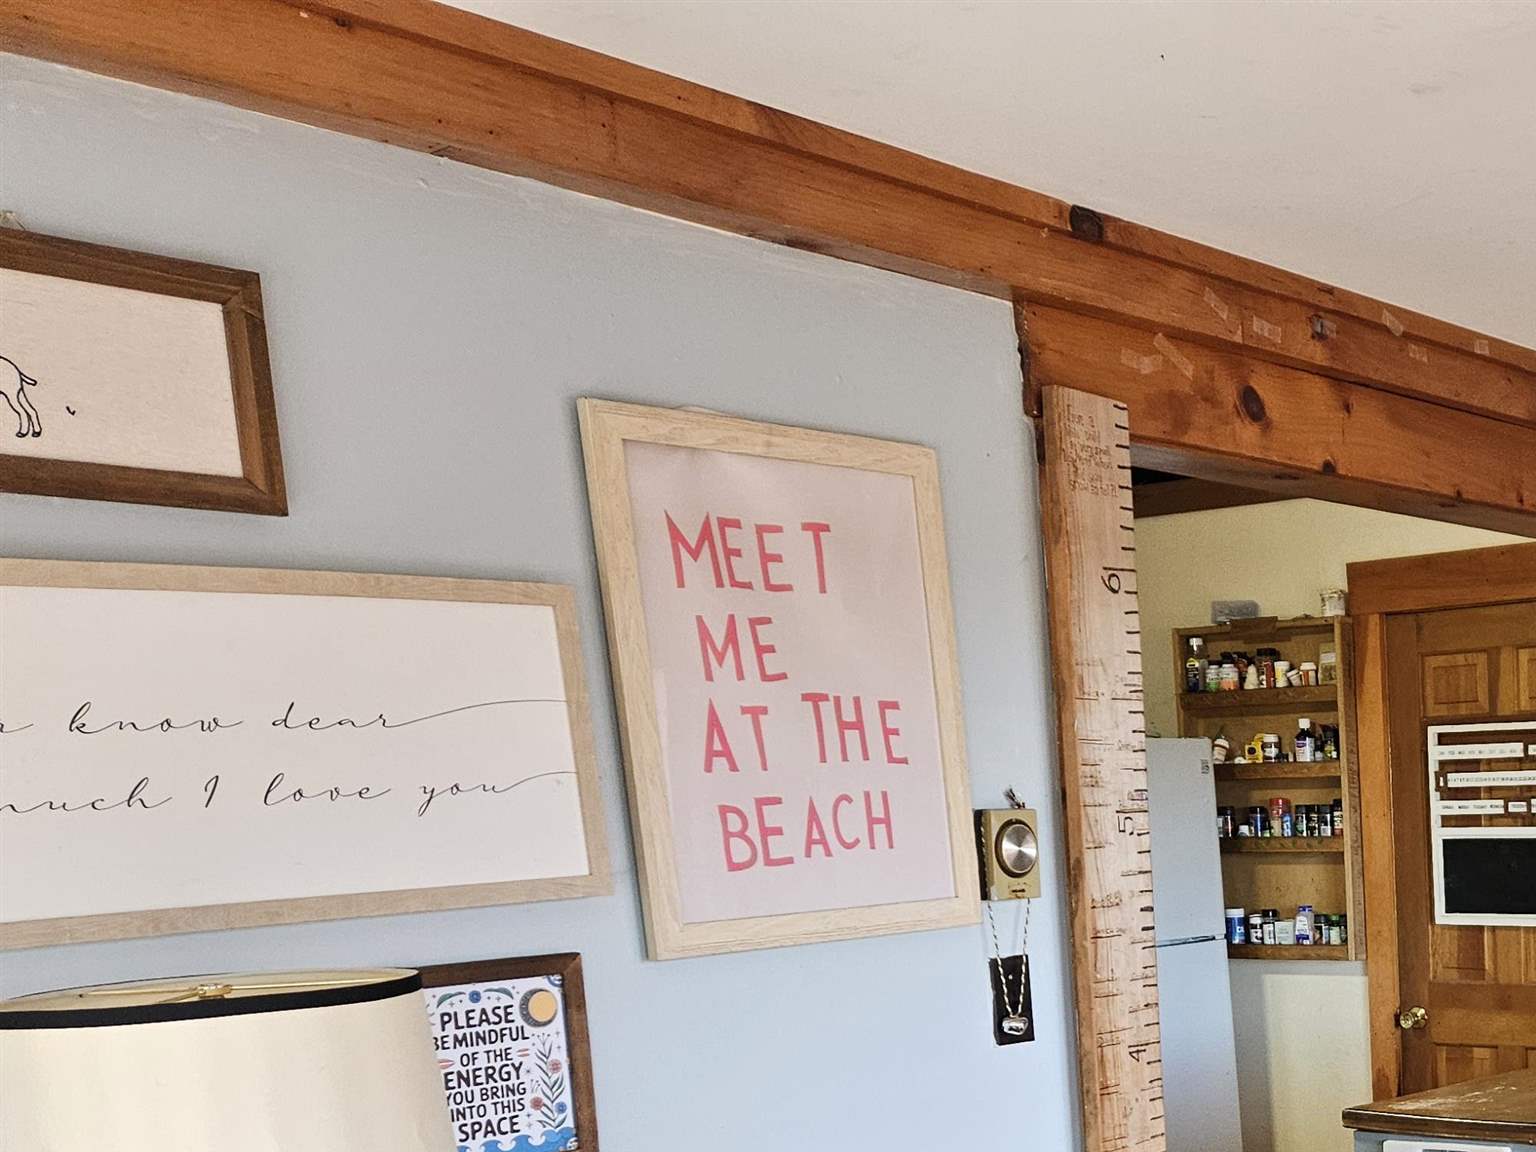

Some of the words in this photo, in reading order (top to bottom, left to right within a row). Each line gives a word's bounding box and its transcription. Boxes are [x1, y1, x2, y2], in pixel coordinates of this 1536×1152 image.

[664, 510, 831, 593] MEET
[696, 614, 788, 682] ME
[69, 701, 243, 734] know
[703, 698, 769, 773] AT
[801, 692, 909, 764] THE
[203, 775, 220, 808] I
[264, 773, 392, 806] love
[718, 791, 894, 872] BEACH
[440, 1005, 515, 1032] PLEASE
[453, 1026, 530, 1050] MINDFUL
[460, 1052, 479, 1067] OF
[484, 1047, 513, 1063] THE
[443, 1061, 523, 1091] ENERGY
[480, 1082, 527, 1101] BRING
[450, 1104, 487, 1122] INTO
[491, 1098, 525, 1115] THIS
[458, 1115, 521, 1142] SPACE
